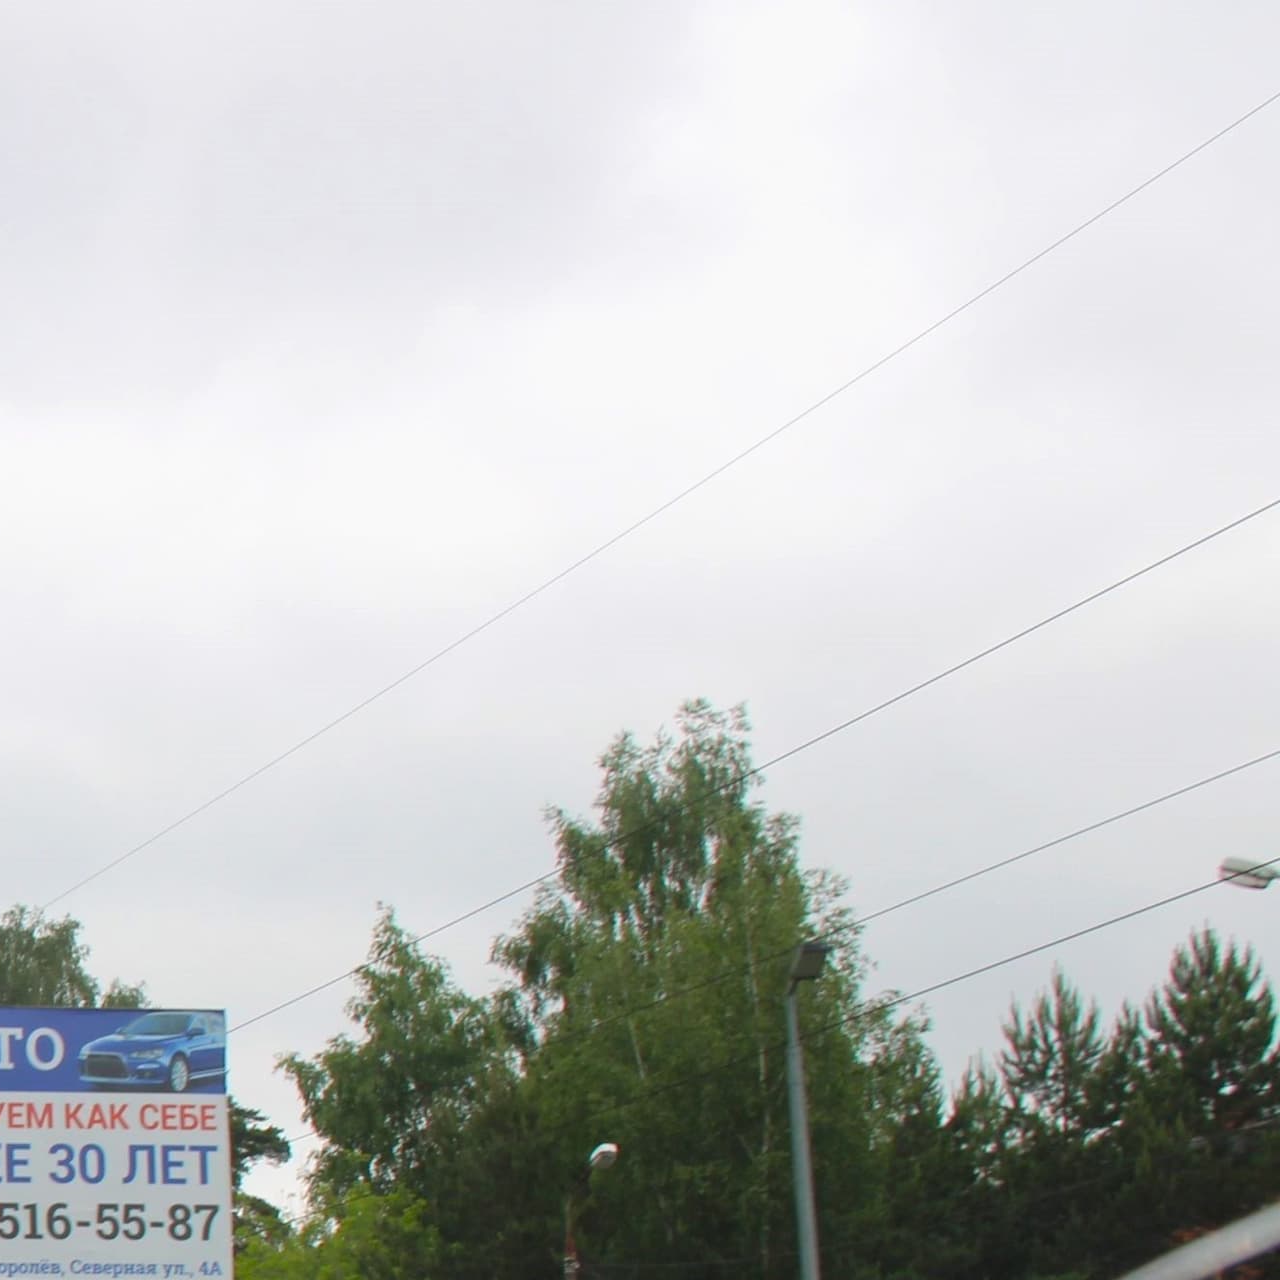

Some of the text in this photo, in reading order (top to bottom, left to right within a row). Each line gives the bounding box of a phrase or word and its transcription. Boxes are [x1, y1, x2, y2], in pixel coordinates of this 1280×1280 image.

[65, 1103, 130, 1130] КАК
[140, 1104, 217, 1131] СЕБЕ
[48, 1143, 106, 1184] 30
[122, 1144, 218, 1185] ЛЕТ
[70, 1259, 157, 1278] Северная
[198, 1261, 222, 1276] 4А
